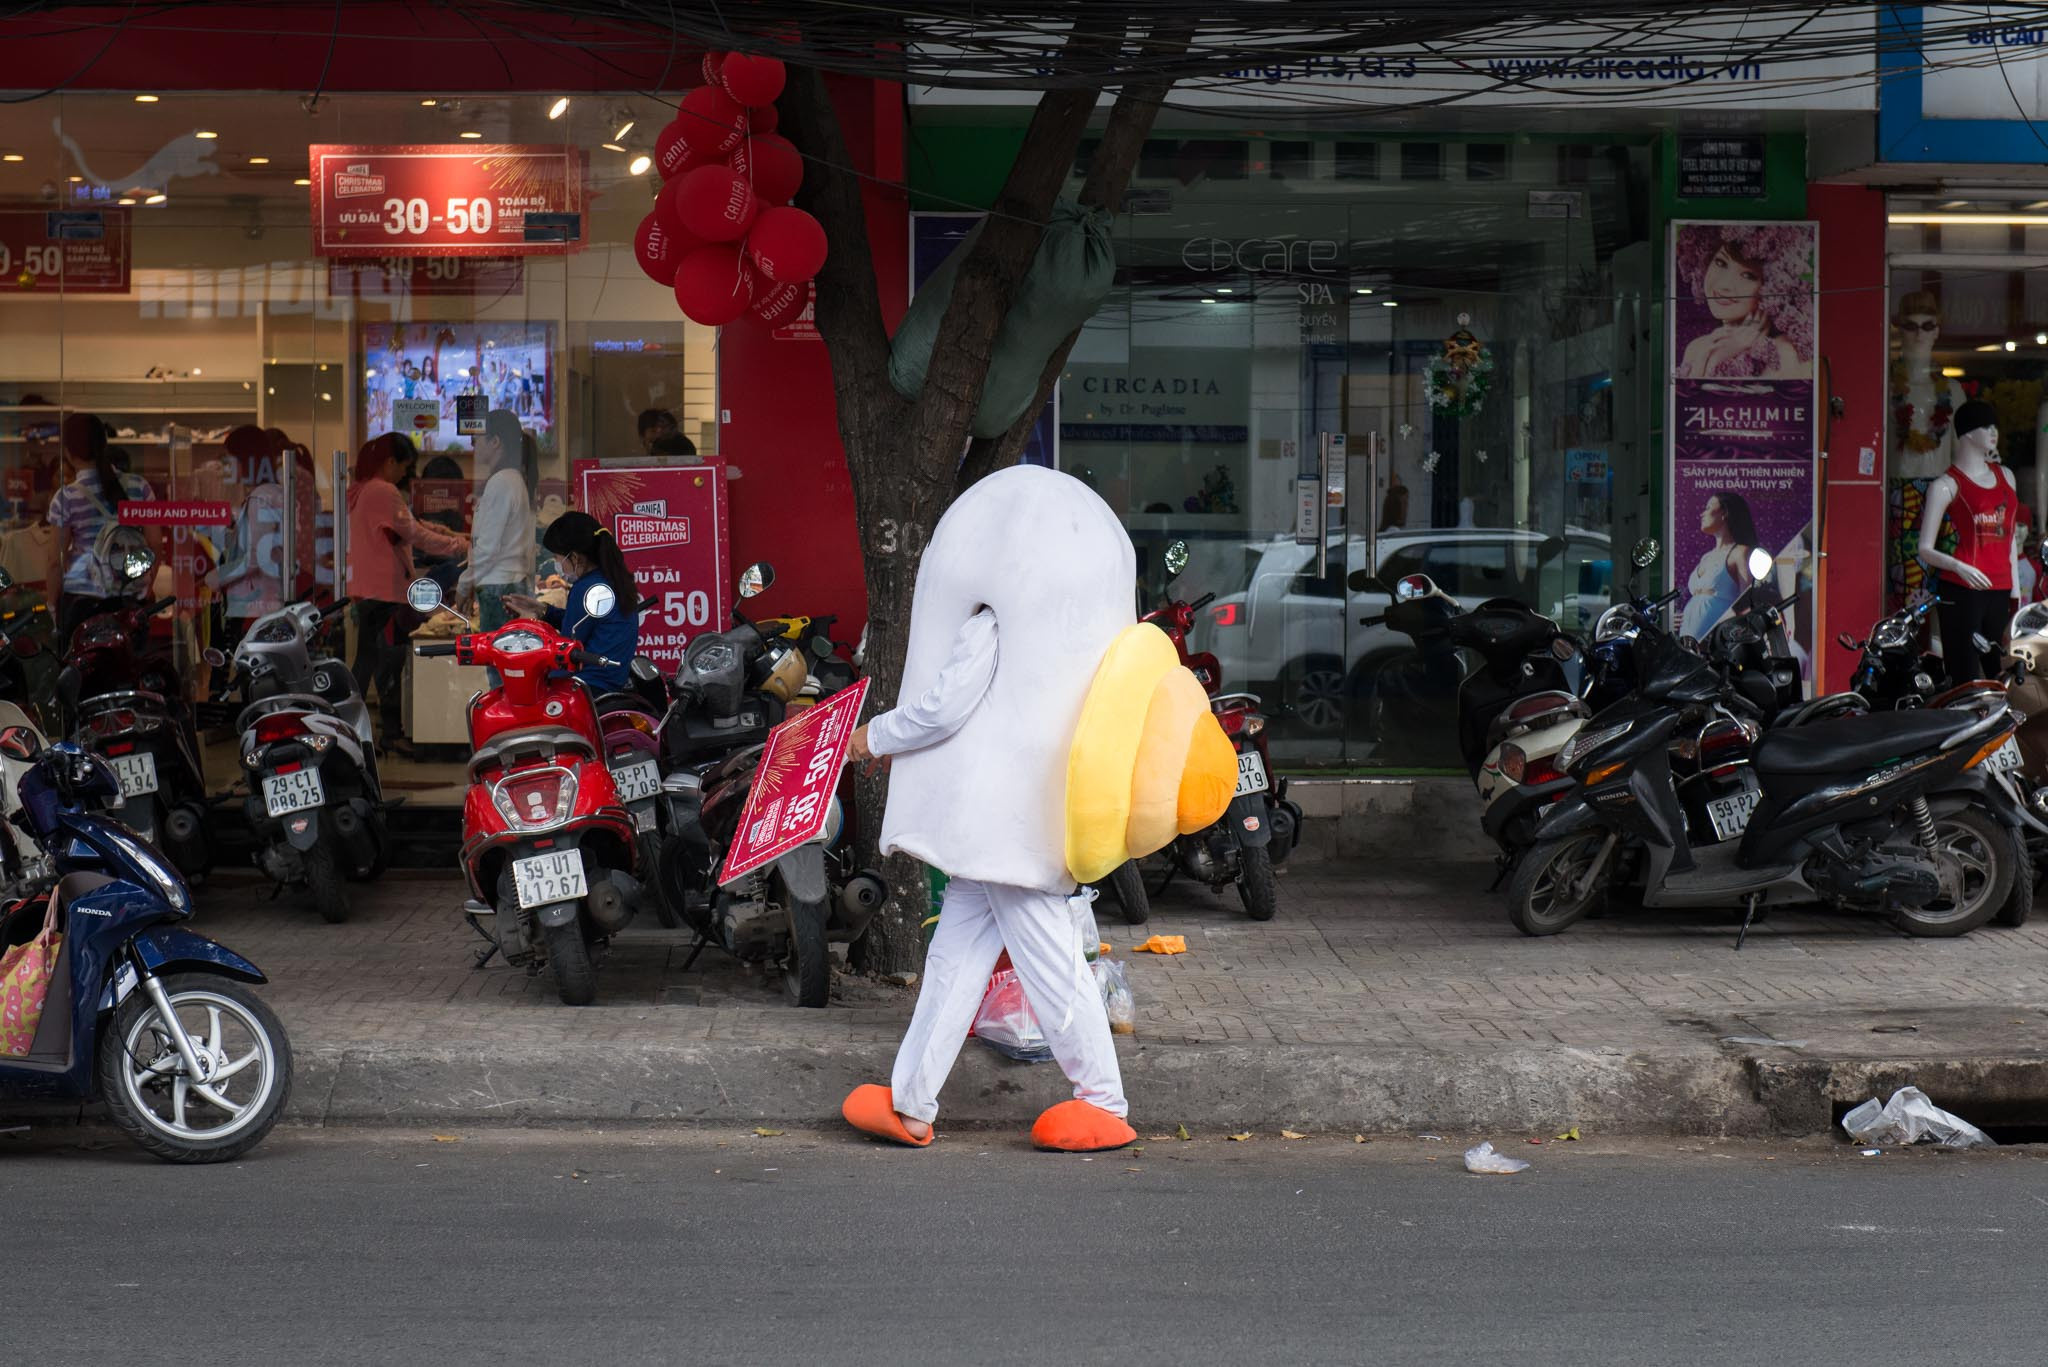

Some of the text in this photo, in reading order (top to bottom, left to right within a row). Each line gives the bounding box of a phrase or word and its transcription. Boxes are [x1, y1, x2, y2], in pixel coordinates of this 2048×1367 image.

[662, 136, 689, 168] CANIF
[723, 180, 746, 221] CANIFA
[338, 211, 357, 224] ƯU
[357, 211, 381, 224] ĐÃI
[1296, 282, 1335, 305] SPA
[760, 284, 800, 321] CANIFA
[1082, 377, 1221, 395] CIRCADIA
[397, 402, 436, 410] WELCOME
[464, 421, 483, 429] VISA
[1684, 406, 1806, 429] ALCHIMIE
[1708, 420, 1769, 429] FOREVER
[1682, 464, 1707, 477] SẢN
[1741, 465, 1771, 477] THIÊN
[1772, 465, 1805, 477] NHIÊN
[1694, 478, 1724, 489] HÀNG
[131, 508, 219, 518] PUSH AND PULL
[636, 503, 662, 517] CANIFA
[620, 519, 687, 533] CHRISTMAS
[621, 531, 688, 546] CELEBRATION
[652, 568, 680, 584] ĐÃI
[637, 631, 688, 648] OÀN BỘ
[114, 758, 146, 778] 1-L1
[271, 771, 313, 796] 29-C1
[1596, 791, 1630, 802] HONDA
[1715, 793, 1755, 819] 59-P2
[522, 873, 580, 906] 412.67
[77, 906, 113, 917] HONDA
